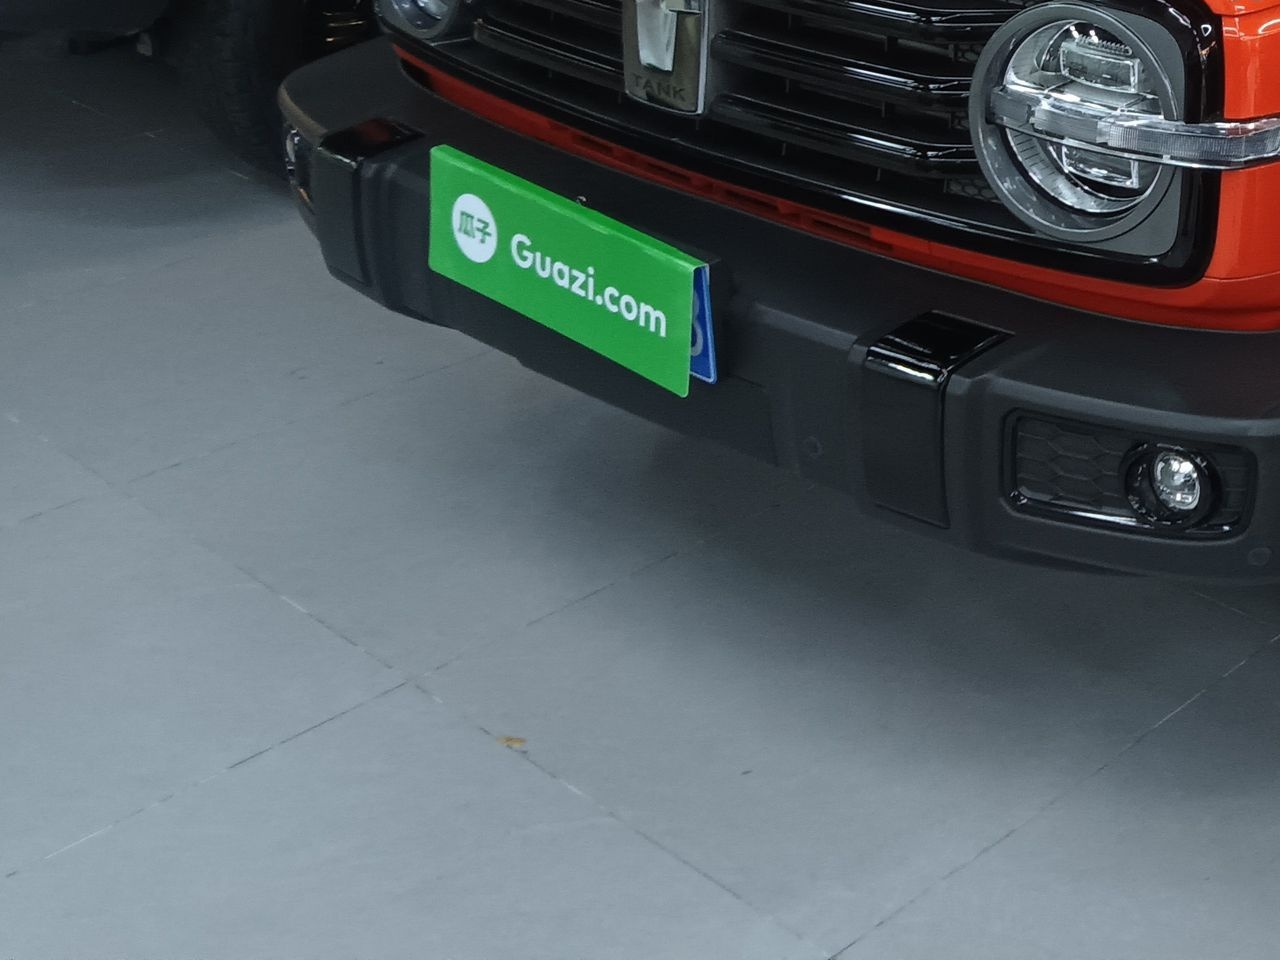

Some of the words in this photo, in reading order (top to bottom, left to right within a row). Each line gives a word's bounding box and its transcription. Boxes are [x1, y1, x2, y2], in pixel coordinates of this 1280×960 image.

[632, 72, 687, 102] TANK
[457, 210, 492, 245] 瓜子
[510, 233, 667, 338] Guazi.com
